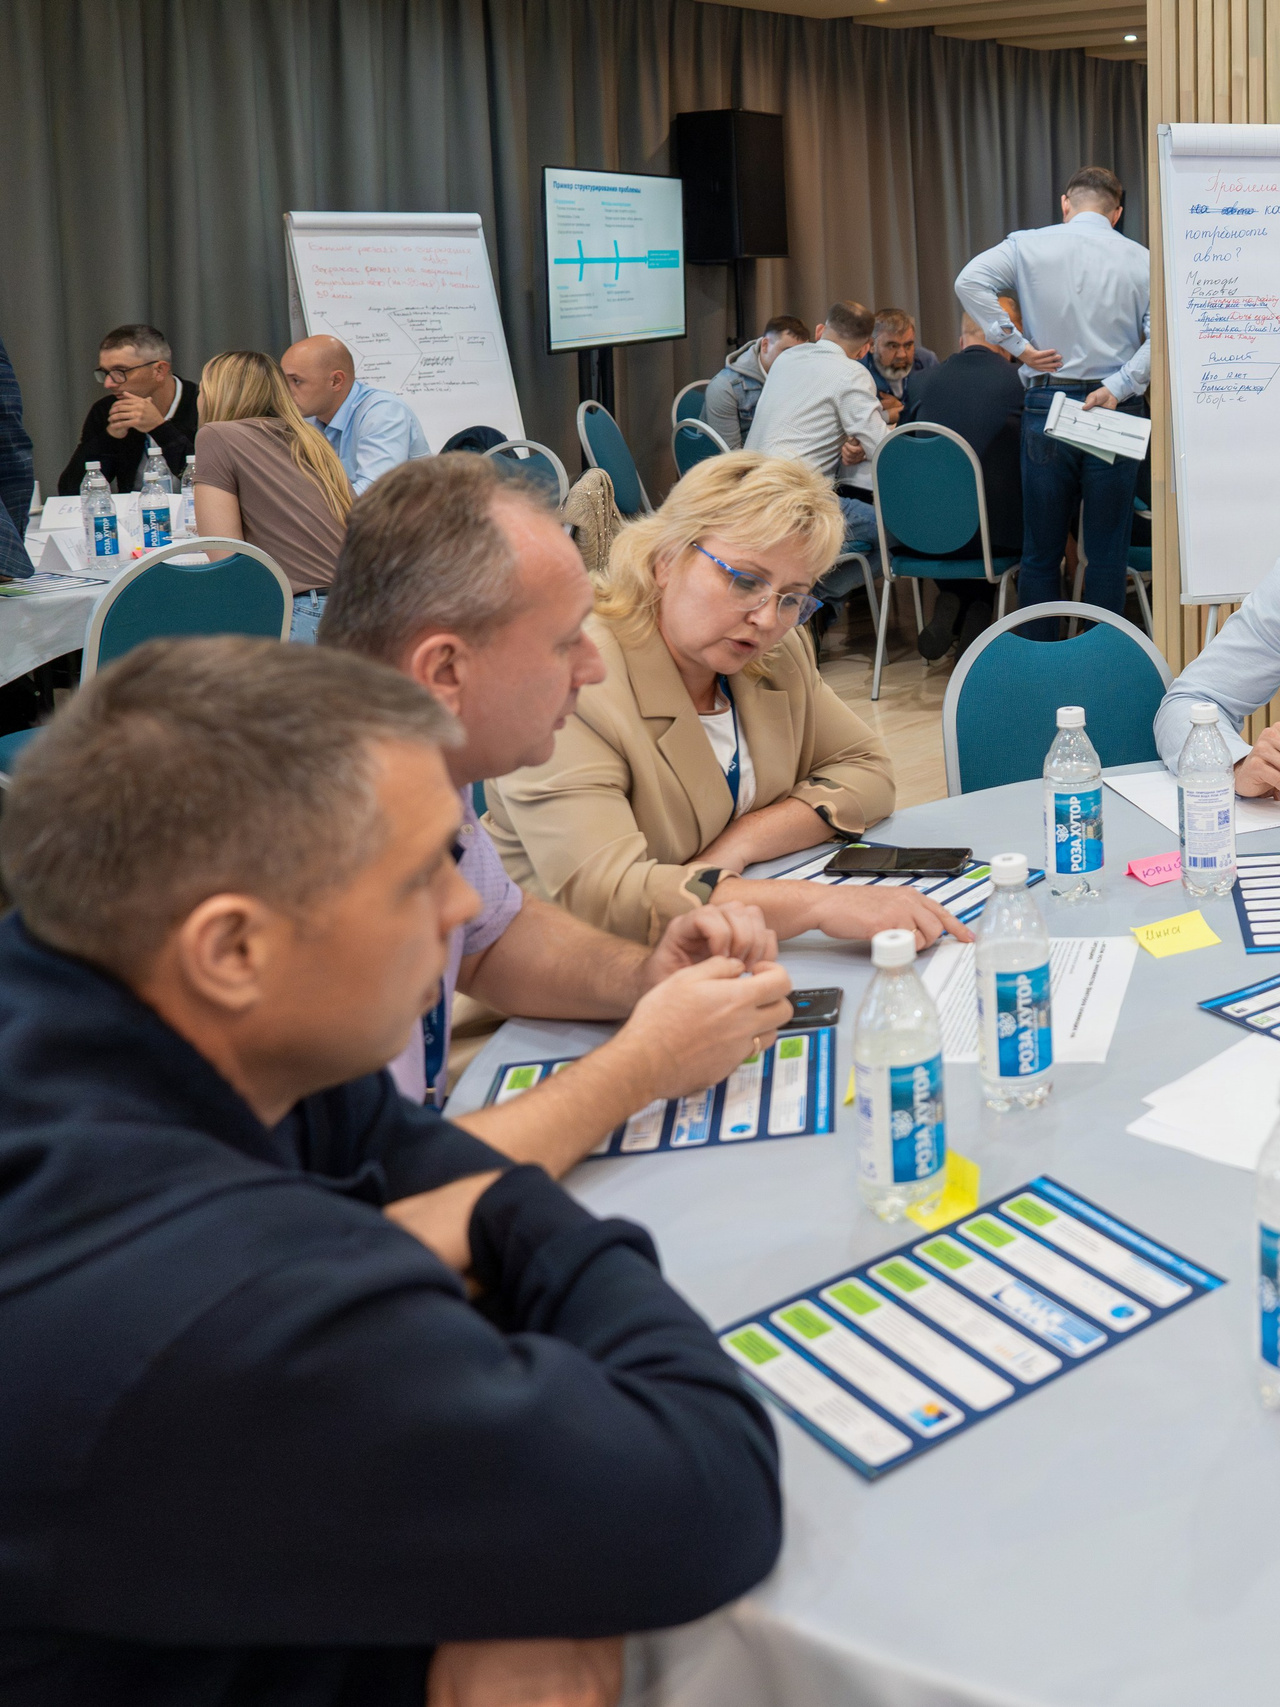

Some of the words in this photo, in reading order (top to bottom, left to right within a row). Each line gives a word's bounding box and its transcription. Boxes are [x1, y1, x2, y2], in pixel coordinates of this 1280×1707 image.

[553, 181, 573, 190] Пример
[1185, 226, 1268, 245] потребность
[1193, 246, 1242, 262] авто?
[1186, 271, 1239, 289] Методы
[103, 517, 111, 537] ХУТОР
[149, 510, 157, 531] ХУТОР
[1069, 796, 1081, 837] ХУТОР
[1071, 839, 1082, 872] РОЗА
[1016, 973, 1033, 1029] ХУТОР
[1018, 1029, 1034, 1074] РОЗА
[912, 1065, 931, 1126] ХУТОР
[914, 1125, 933, 1178] РОЗА
